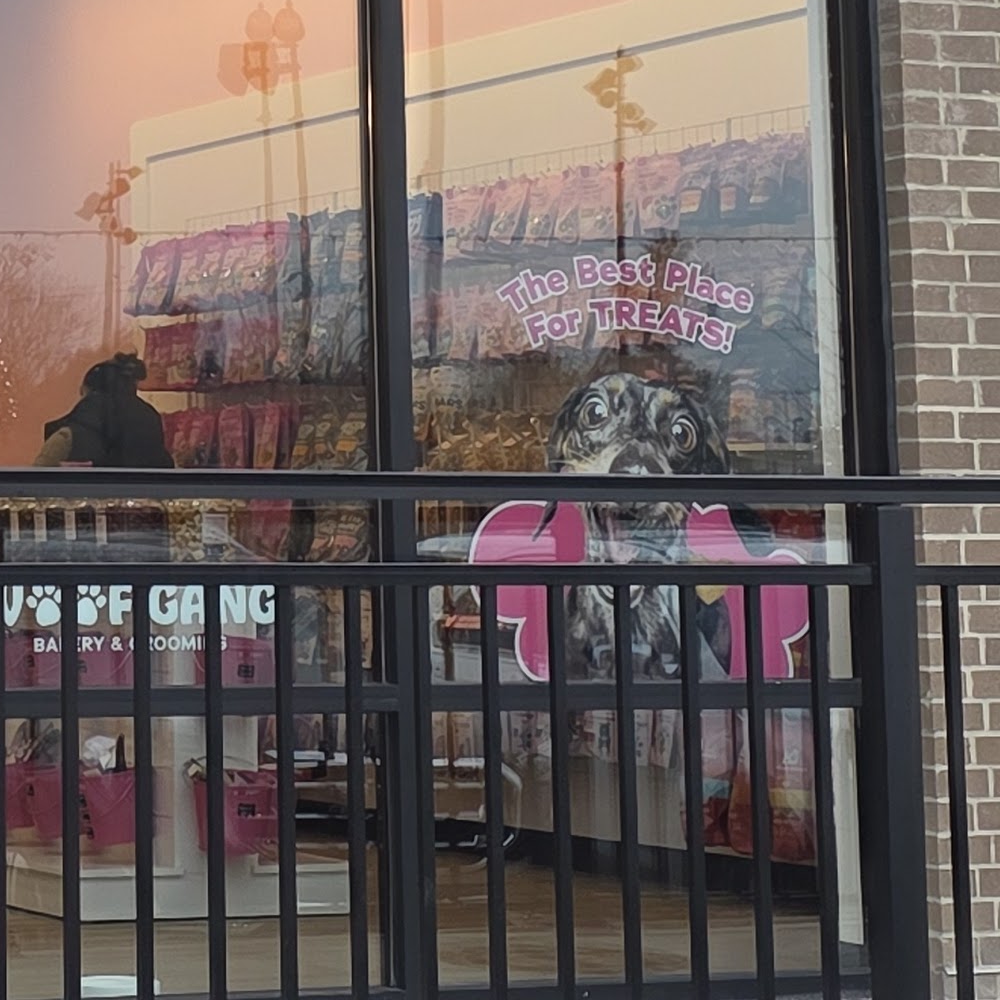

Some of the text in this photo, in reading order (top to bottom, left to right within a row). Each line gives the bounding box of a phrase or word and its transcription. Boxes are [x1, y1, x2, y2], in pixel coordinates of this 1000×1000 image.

[498, 255, 752, 312] The Best Place
[524, 299, 736, 353] For TREATS!
[148, 585, 276, 625] GANG
[34, 636, 104, 653] BARY
[110, 636, 124, 651] &
